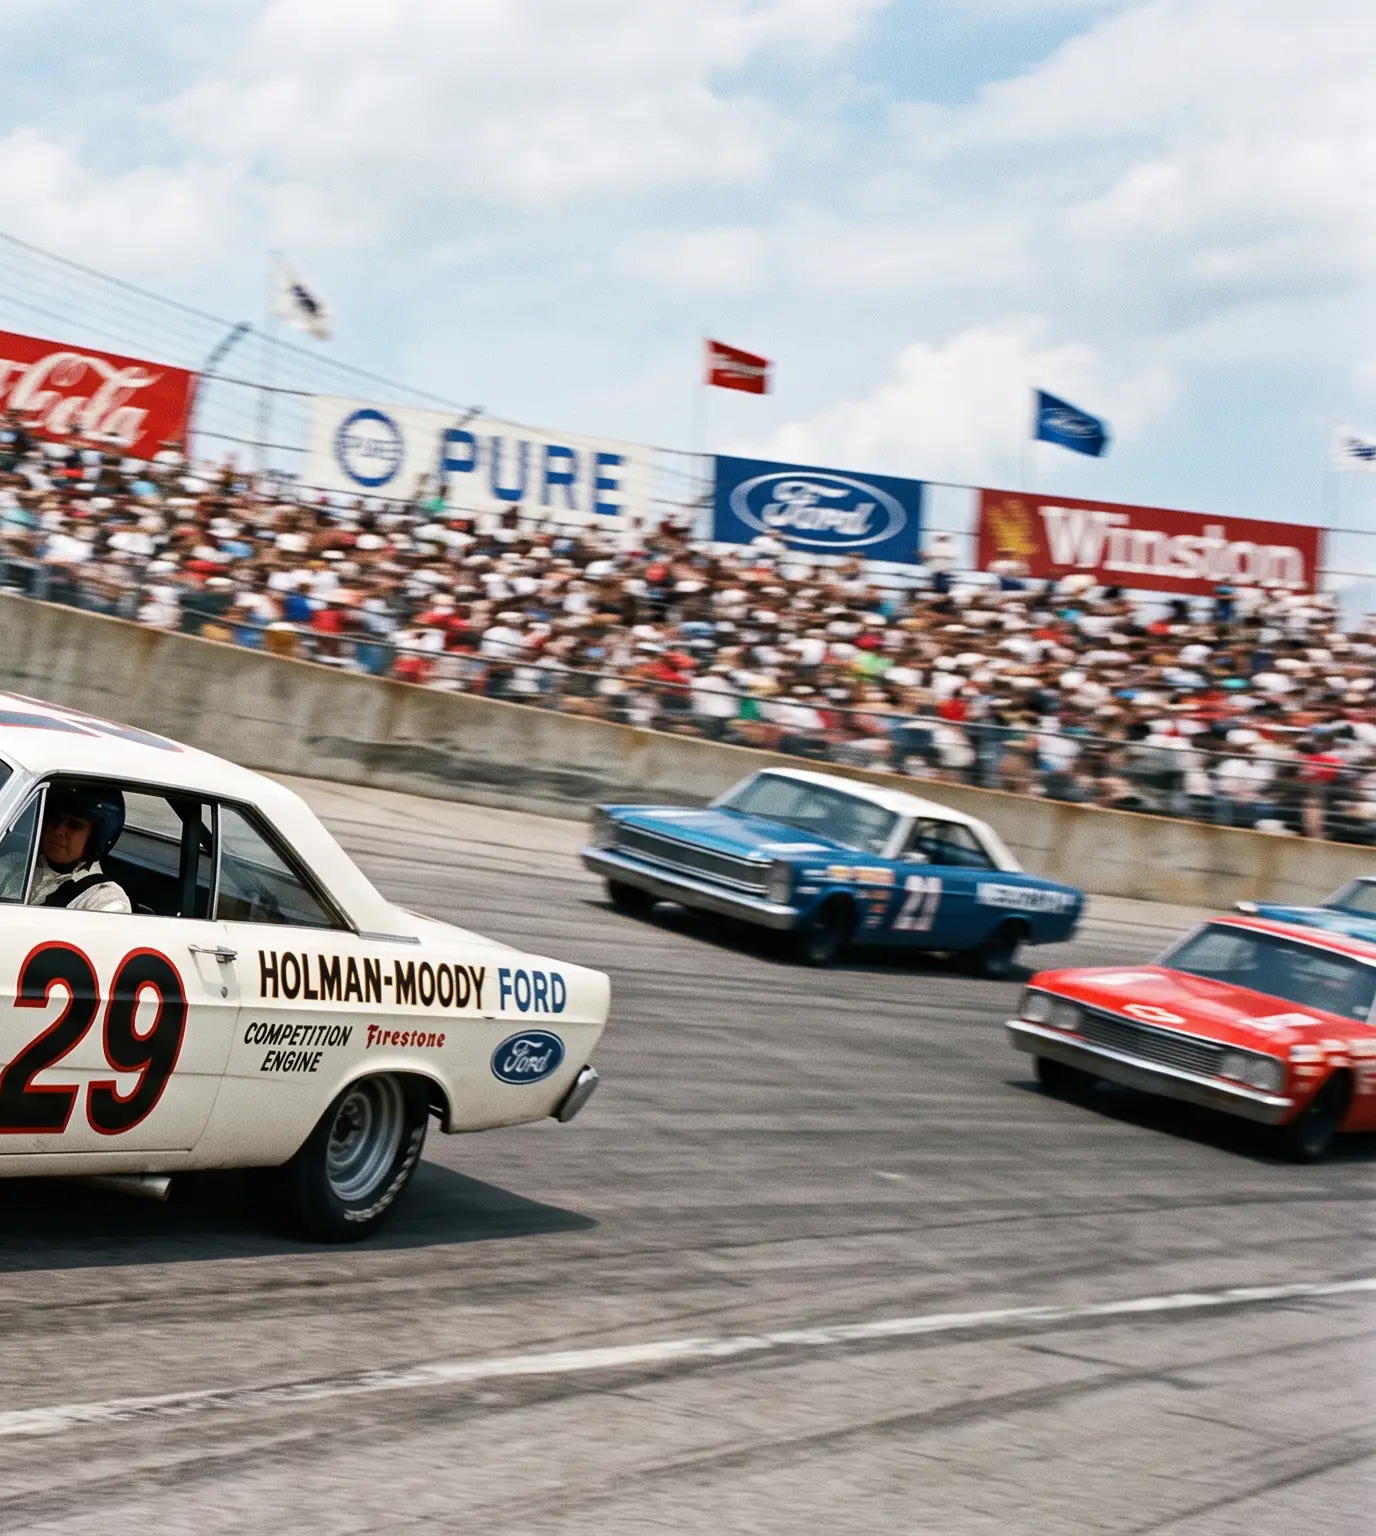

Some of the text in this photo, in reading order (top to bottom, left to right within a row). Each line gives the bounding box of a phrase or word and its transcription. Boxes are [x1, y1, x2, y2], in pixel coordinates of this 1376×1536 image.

[442, 427, 625, 516] PURE
[761, 480, 877, 535] Ford
[1038, 504, 1306, 591] Winston
[258, 949, 567, 1014] HOLMAN-MOODY FORD
[244, 1022, 352, 1047] COMPETITION
[366, 1023, 446, 1049] Firestone
[503, 1039, 554, 1073] Ford
[260, 1050, 323, 1072] ENGINE
